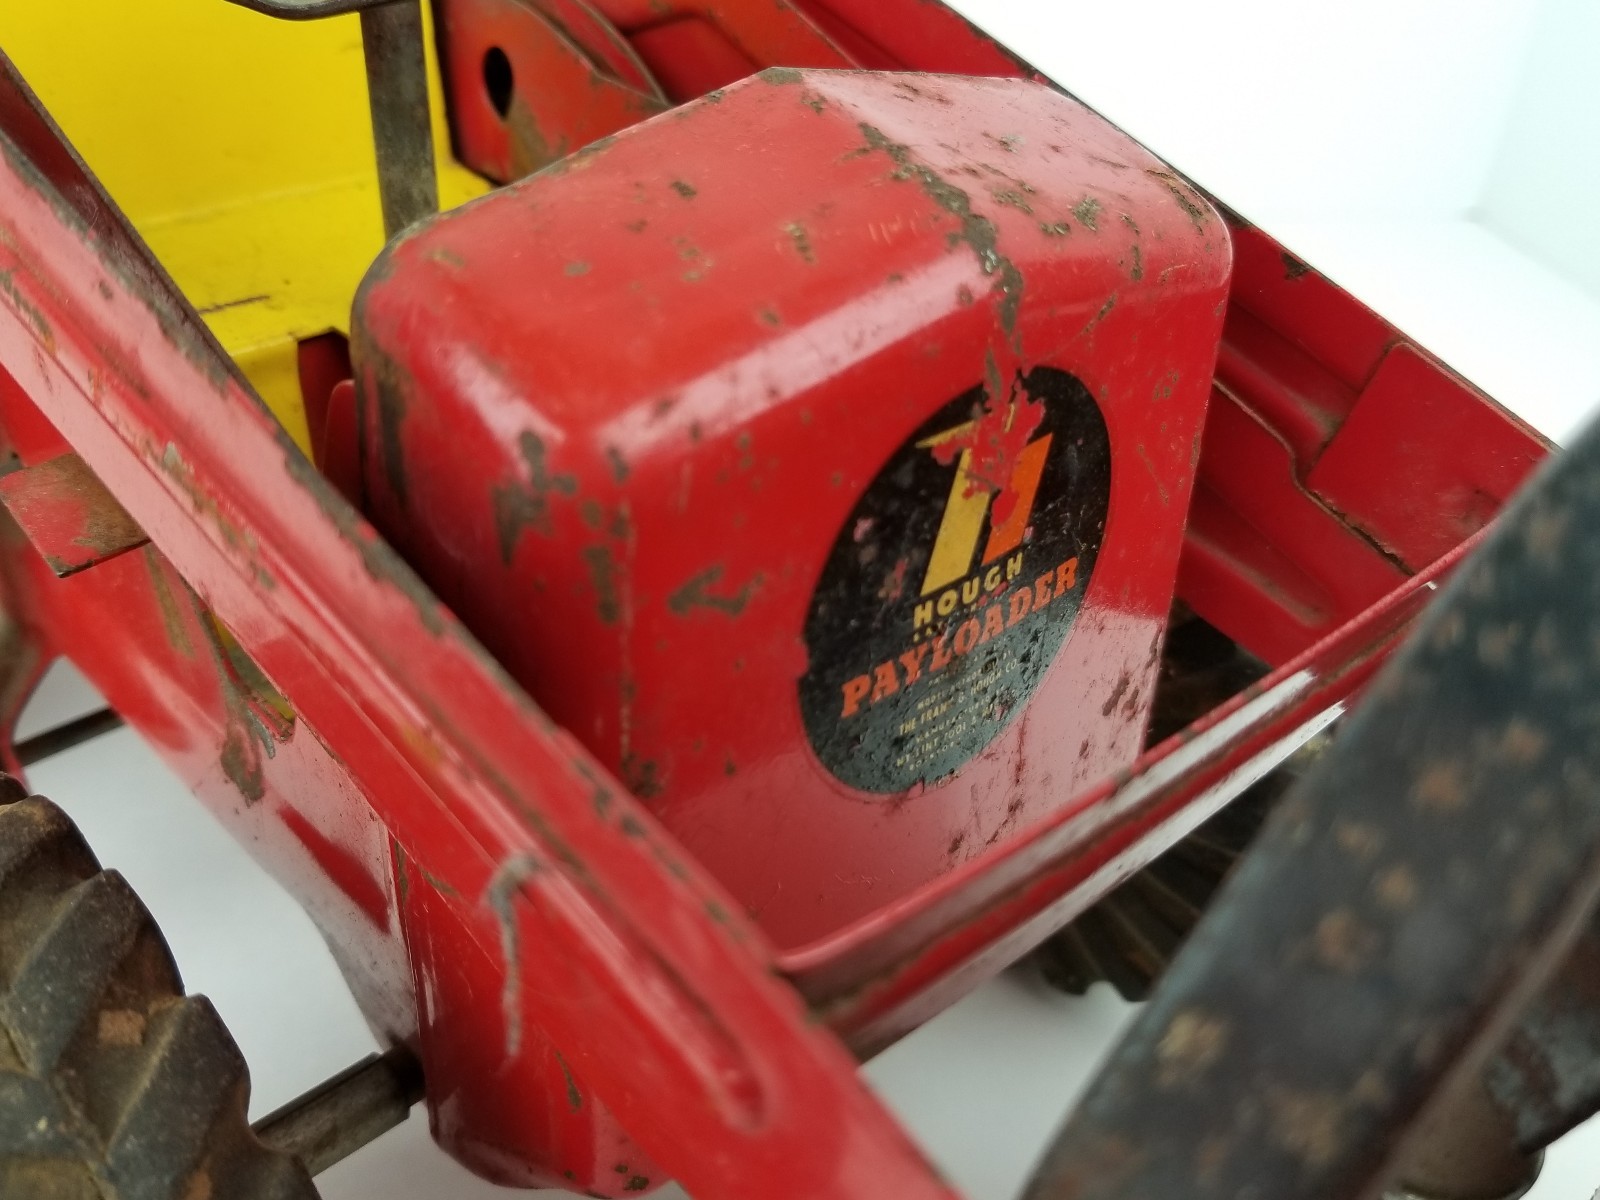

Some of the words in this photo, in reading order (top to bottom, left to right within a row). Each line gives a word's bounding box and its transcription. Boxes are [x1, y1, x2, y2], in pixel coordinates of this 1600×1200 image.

[913, 552, 1024, 629] HOUGH
[840, 556, 1079, 719] PAYLOADER
[899, 717, 916, 736] THE
[970, 668, 1004, 696] HOUGH
